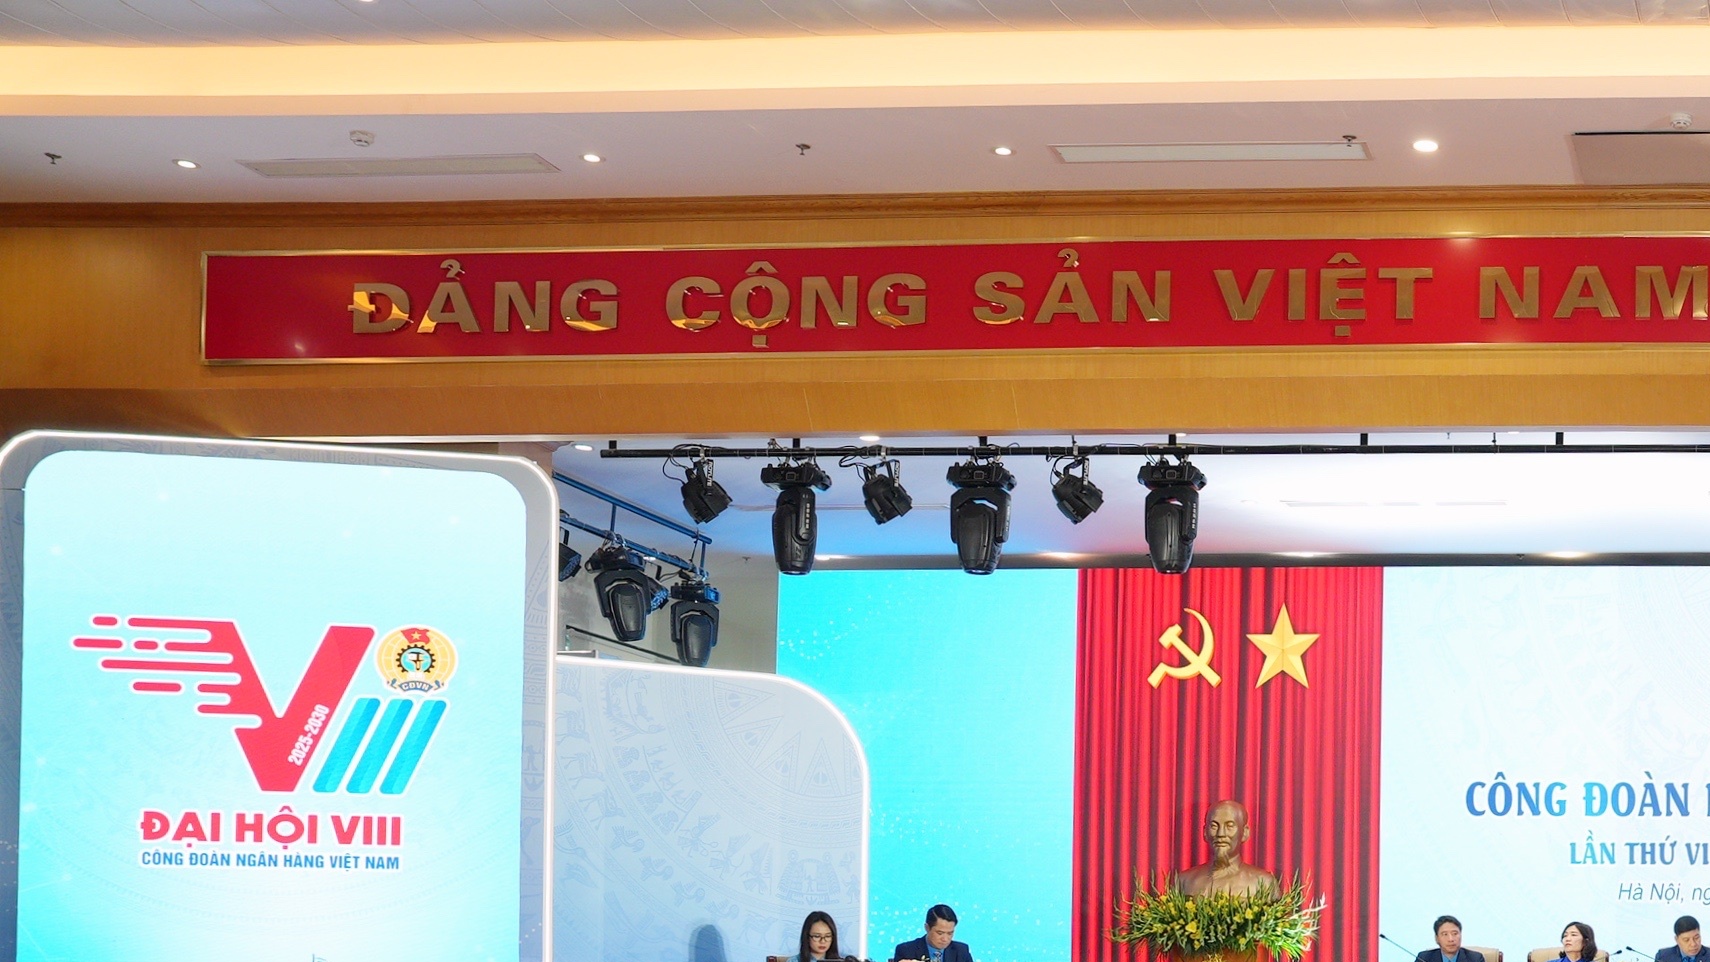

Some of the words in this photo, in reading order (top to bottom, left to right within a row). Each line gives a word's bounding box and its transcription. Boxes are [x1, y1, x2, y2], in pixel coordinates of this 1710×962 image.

[348, 259, 620, 335] ĐẢNG
[665, 261, 928, 348] CỘNG
[973, 248, 1172, 325] SẢN
[1214, 252, 1434, 337] VIỆT
[1478, 265, 1708, 321] NAM
[288, 704, 330, 767] 2025-2030
[1465, 771, 1568, 817] CÔNG
[1582, 770, 1691, 818] ĐOÀN
[140, 810, 221, 849] ĐẠI
[235, 805, 319, 850] HỘI
[330, 814, 402, 846] VIII
[1569, 829, 1617, 865] LẦN
[1624, 836, 1678, 866] THỨ
[141, 849, 184, 866] CÔNG
[188, 850, 231, 867] ĐOÀN
[235, 851, 279, 868] NGÂN
[283, 854, 325, 869] HÀNG
[329, 852, 361, 872] VIỆT
[365, 855, 400, 870] NAM
[1618, 882, 1644, 901] Hà
[1649, 882, 1687, 905] Nội,
